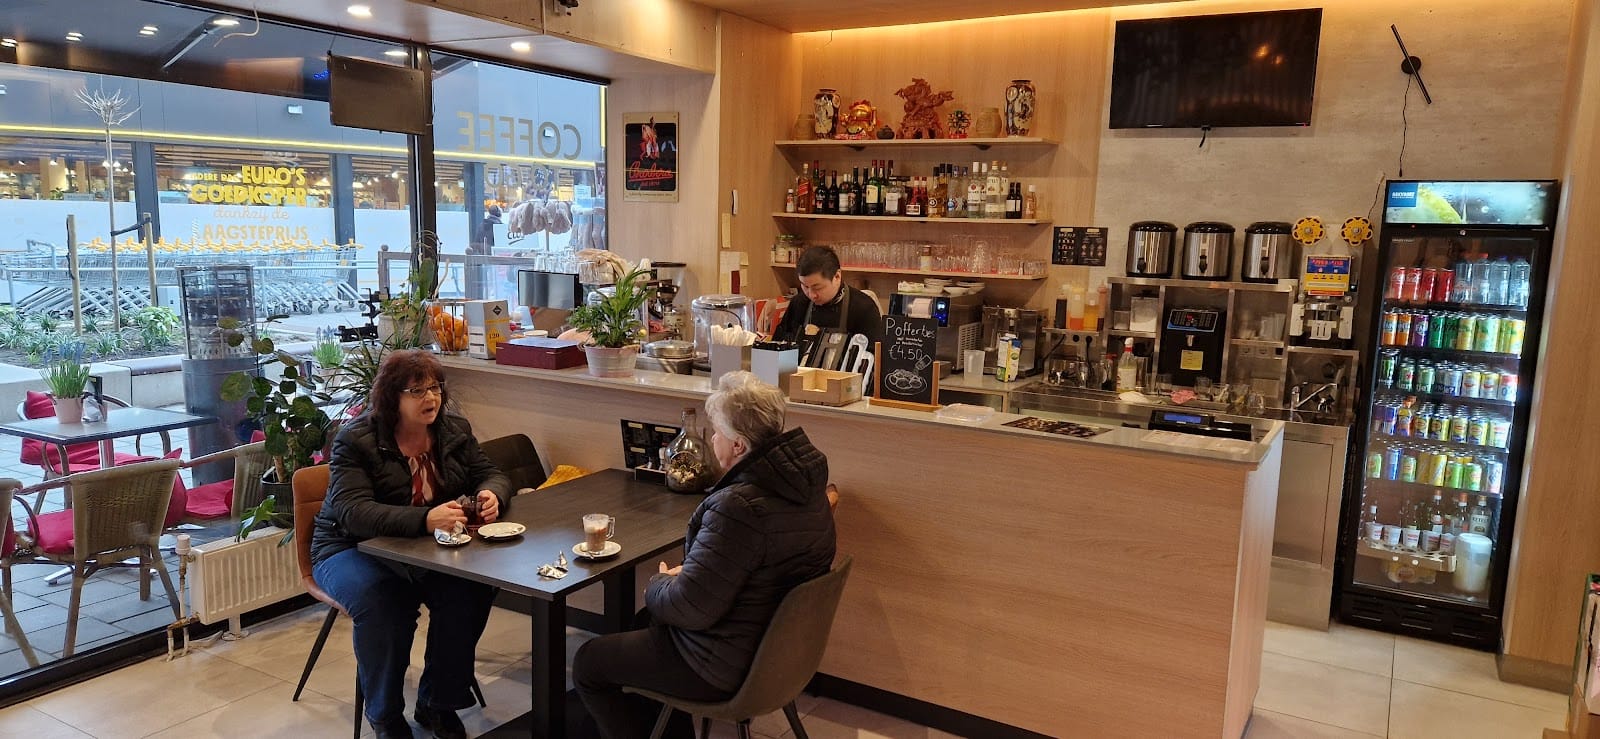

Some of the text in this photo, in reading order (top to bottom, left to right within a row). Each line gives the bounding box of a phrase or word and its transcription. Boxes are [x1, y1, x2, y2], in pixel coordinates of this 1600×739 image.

[242, 165, 305, 186] EURO'S
[191, 183, 307, 208] GOEDKOPER
[272, 205, 290, 219] de
[203, 223, 308, 240] AAGSTEPRIJS
[888, 344, 922, 361] €4.50
